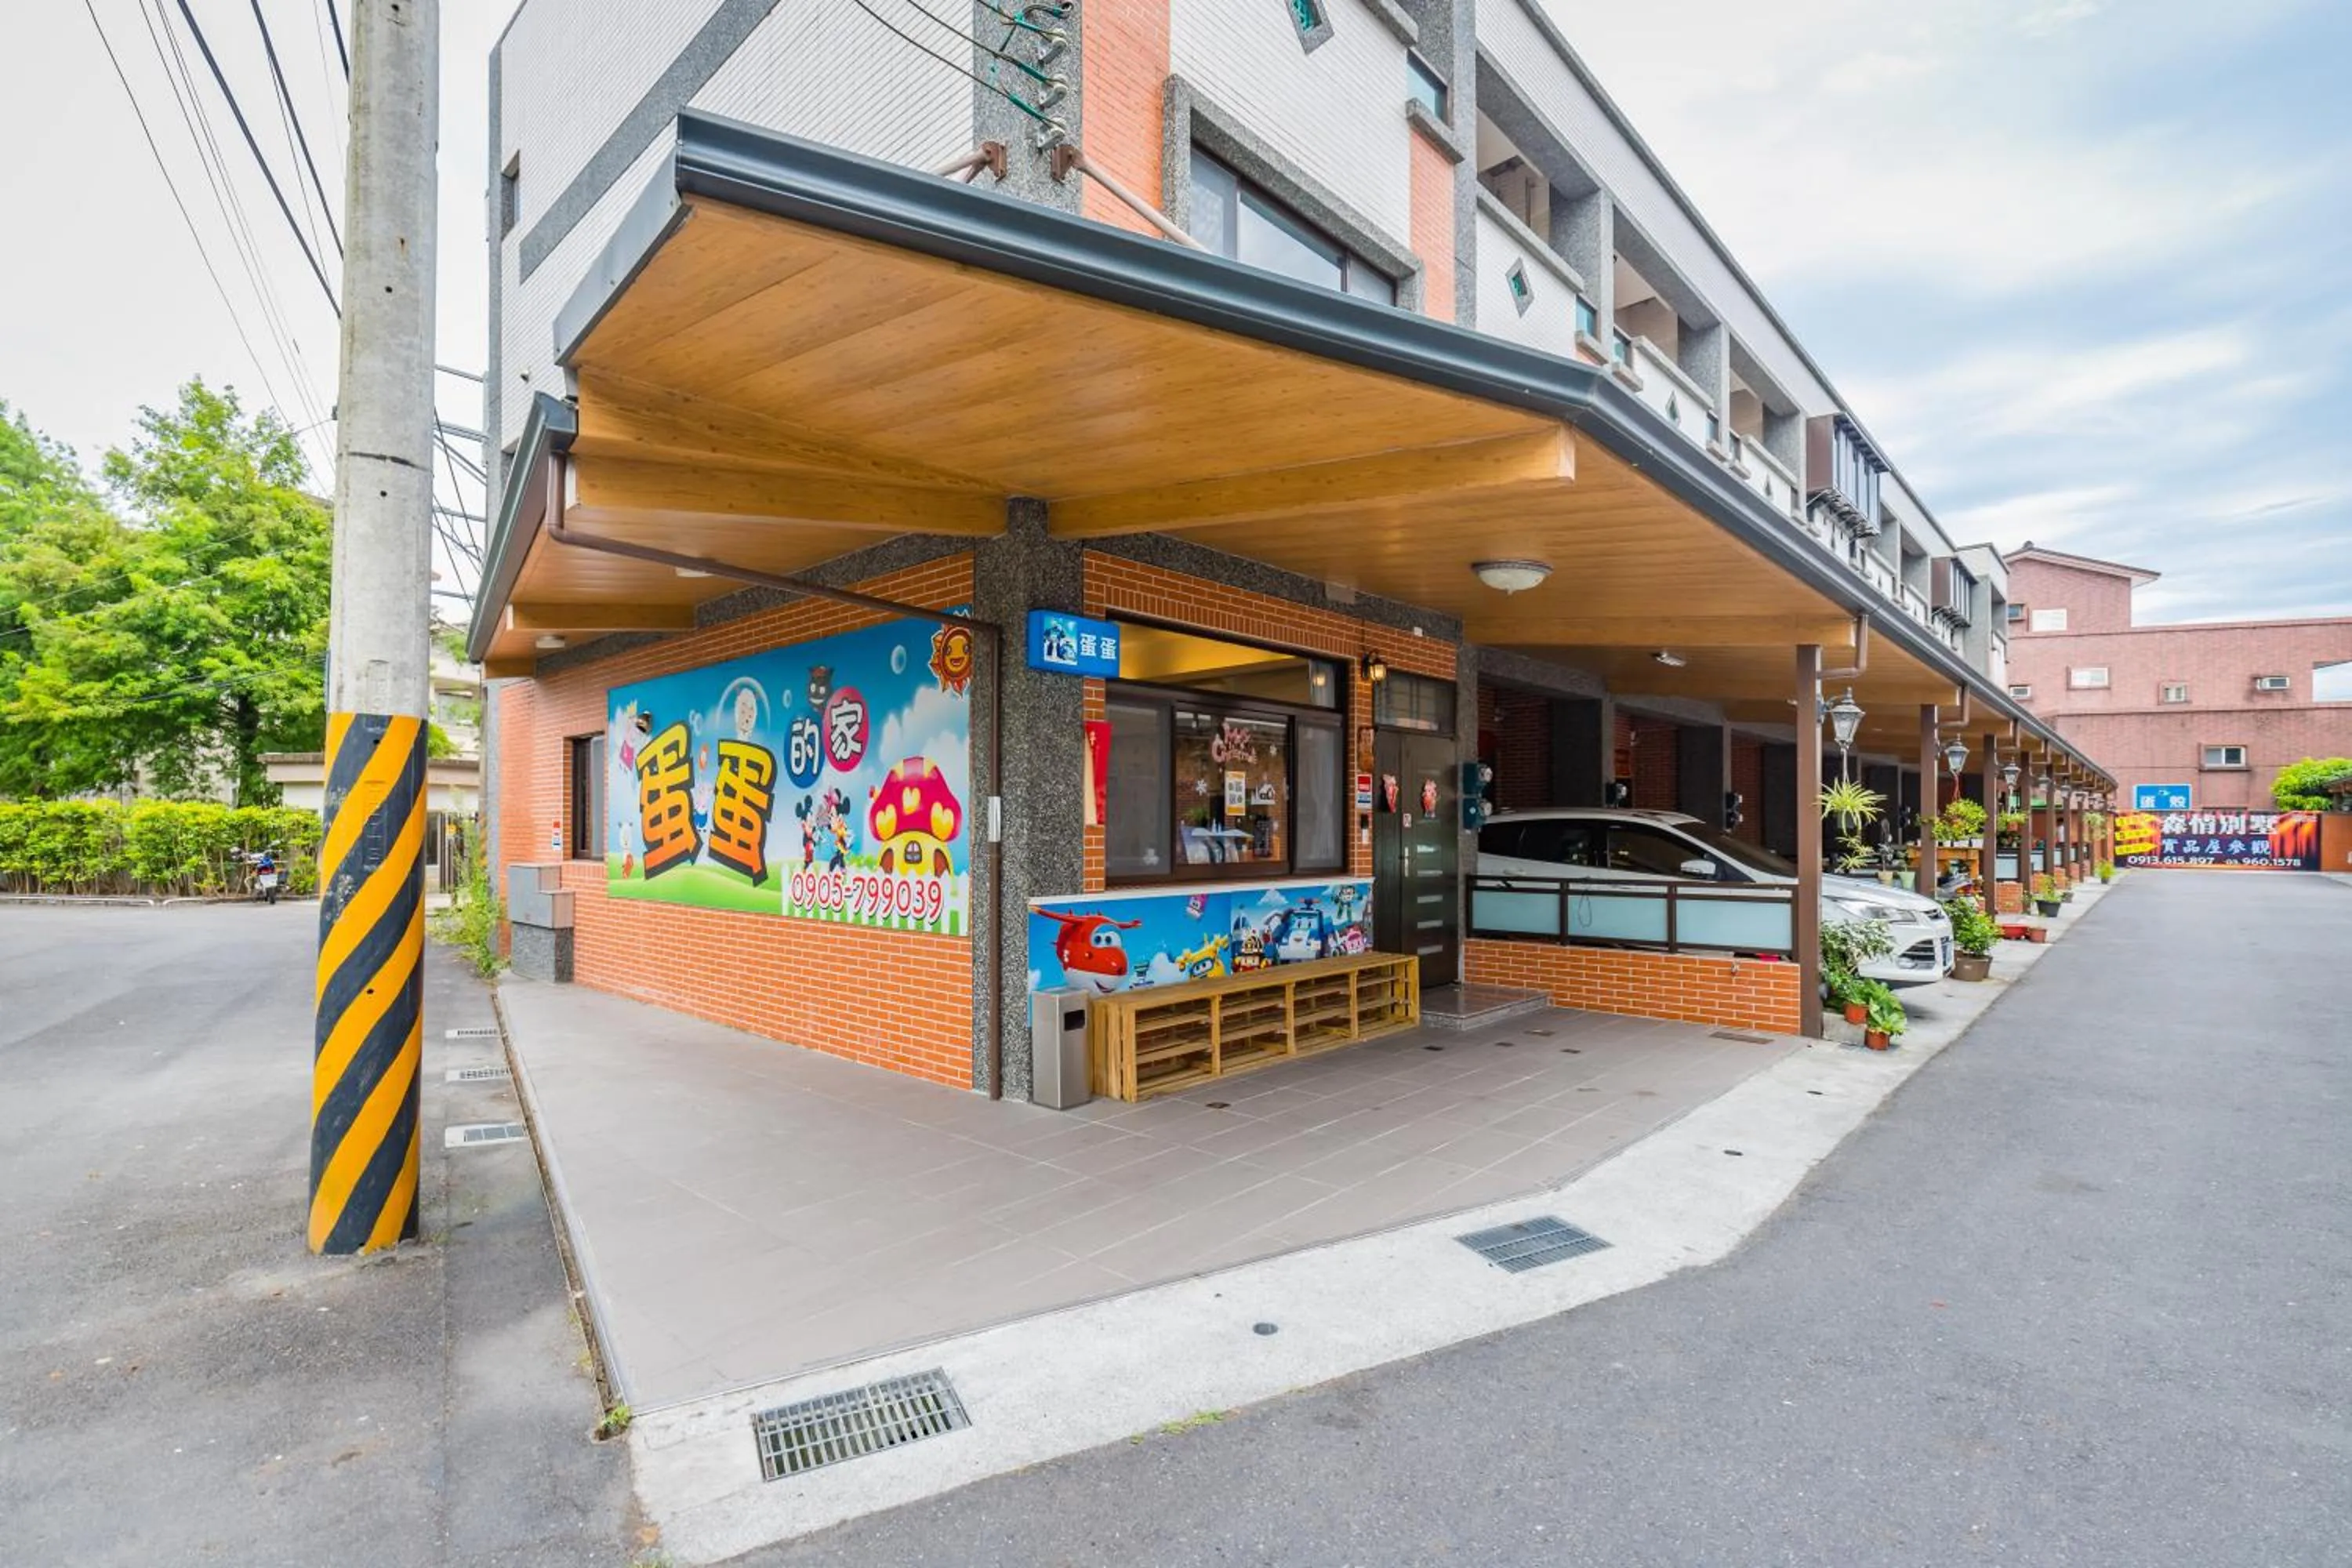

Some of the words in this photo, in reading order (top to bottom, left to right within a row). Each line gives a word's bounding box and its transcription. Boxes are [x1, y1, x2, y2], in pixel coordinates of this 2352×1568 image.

[1080, 633, 1117, 659] 蛋蛋
[636, 699, 864, 887] 蛋蛋的家
[790, 871, 944, 924] 0905-799039
